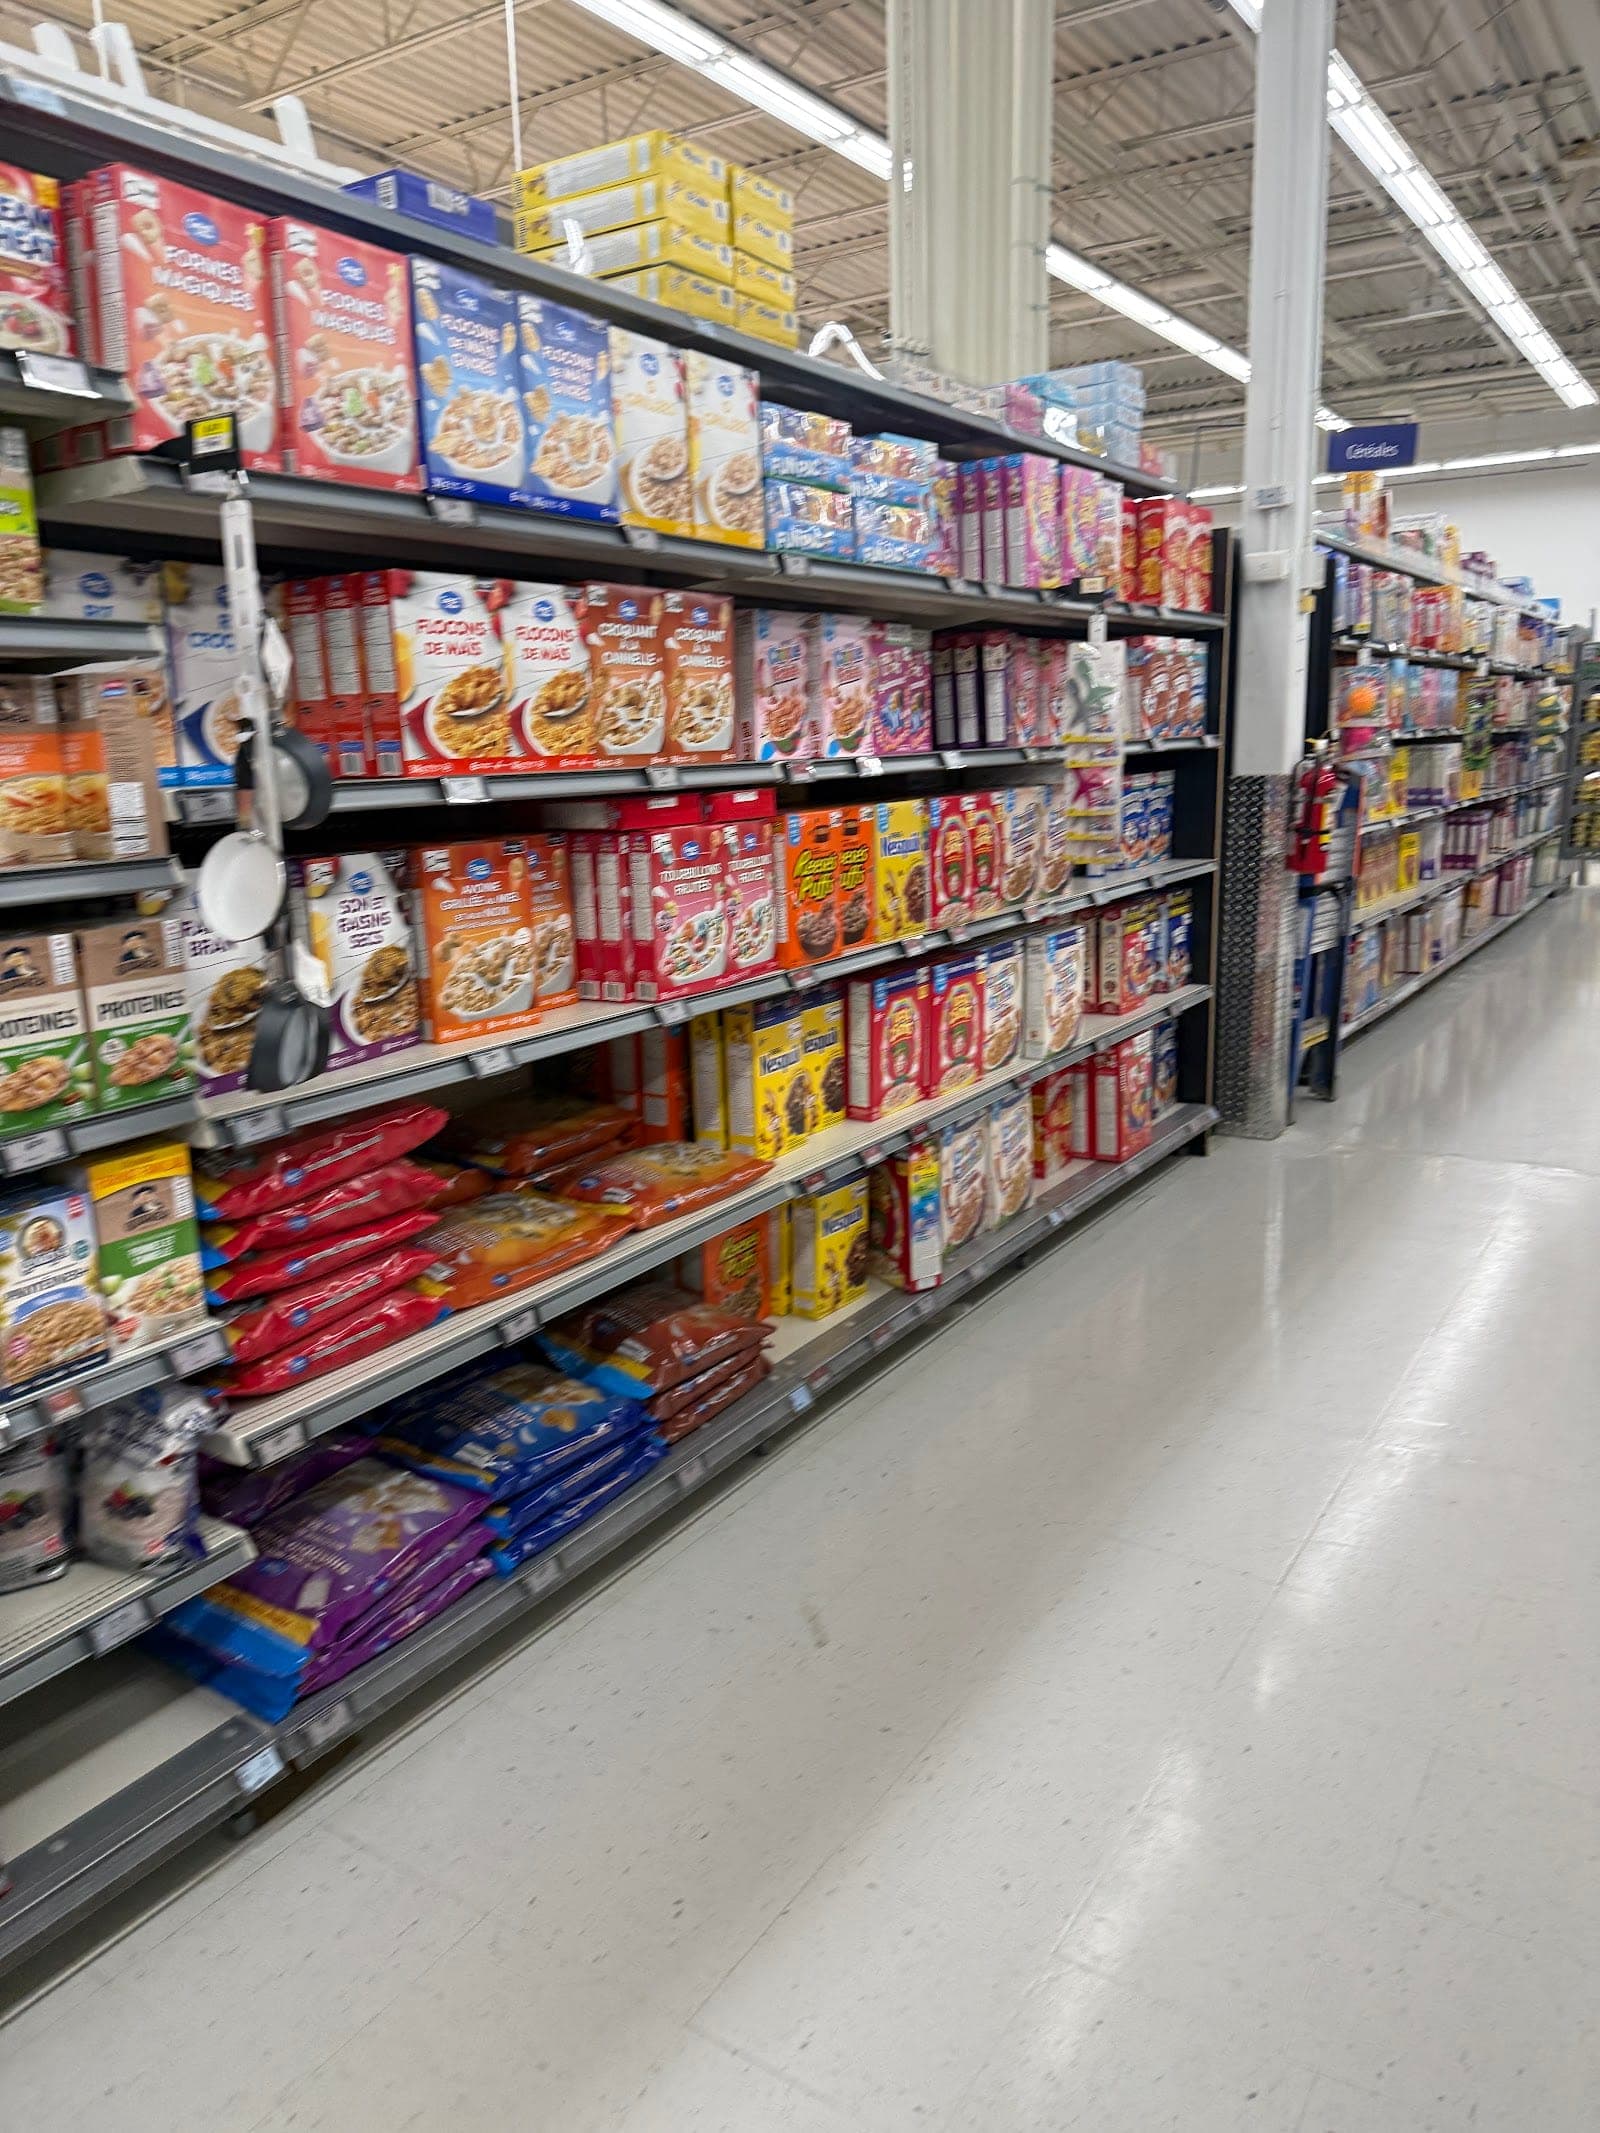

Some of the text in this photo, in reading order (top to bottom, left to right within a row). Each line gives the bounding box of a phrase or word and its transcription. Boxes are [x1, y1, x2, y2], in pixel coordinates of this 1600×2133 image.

[1346, 441, 1399, 460] Céréales
[416, 618, 487, 636] FLOCONS
[424, 642, 443, 655] DE
[337, 912, 392, 934] RAISINS
